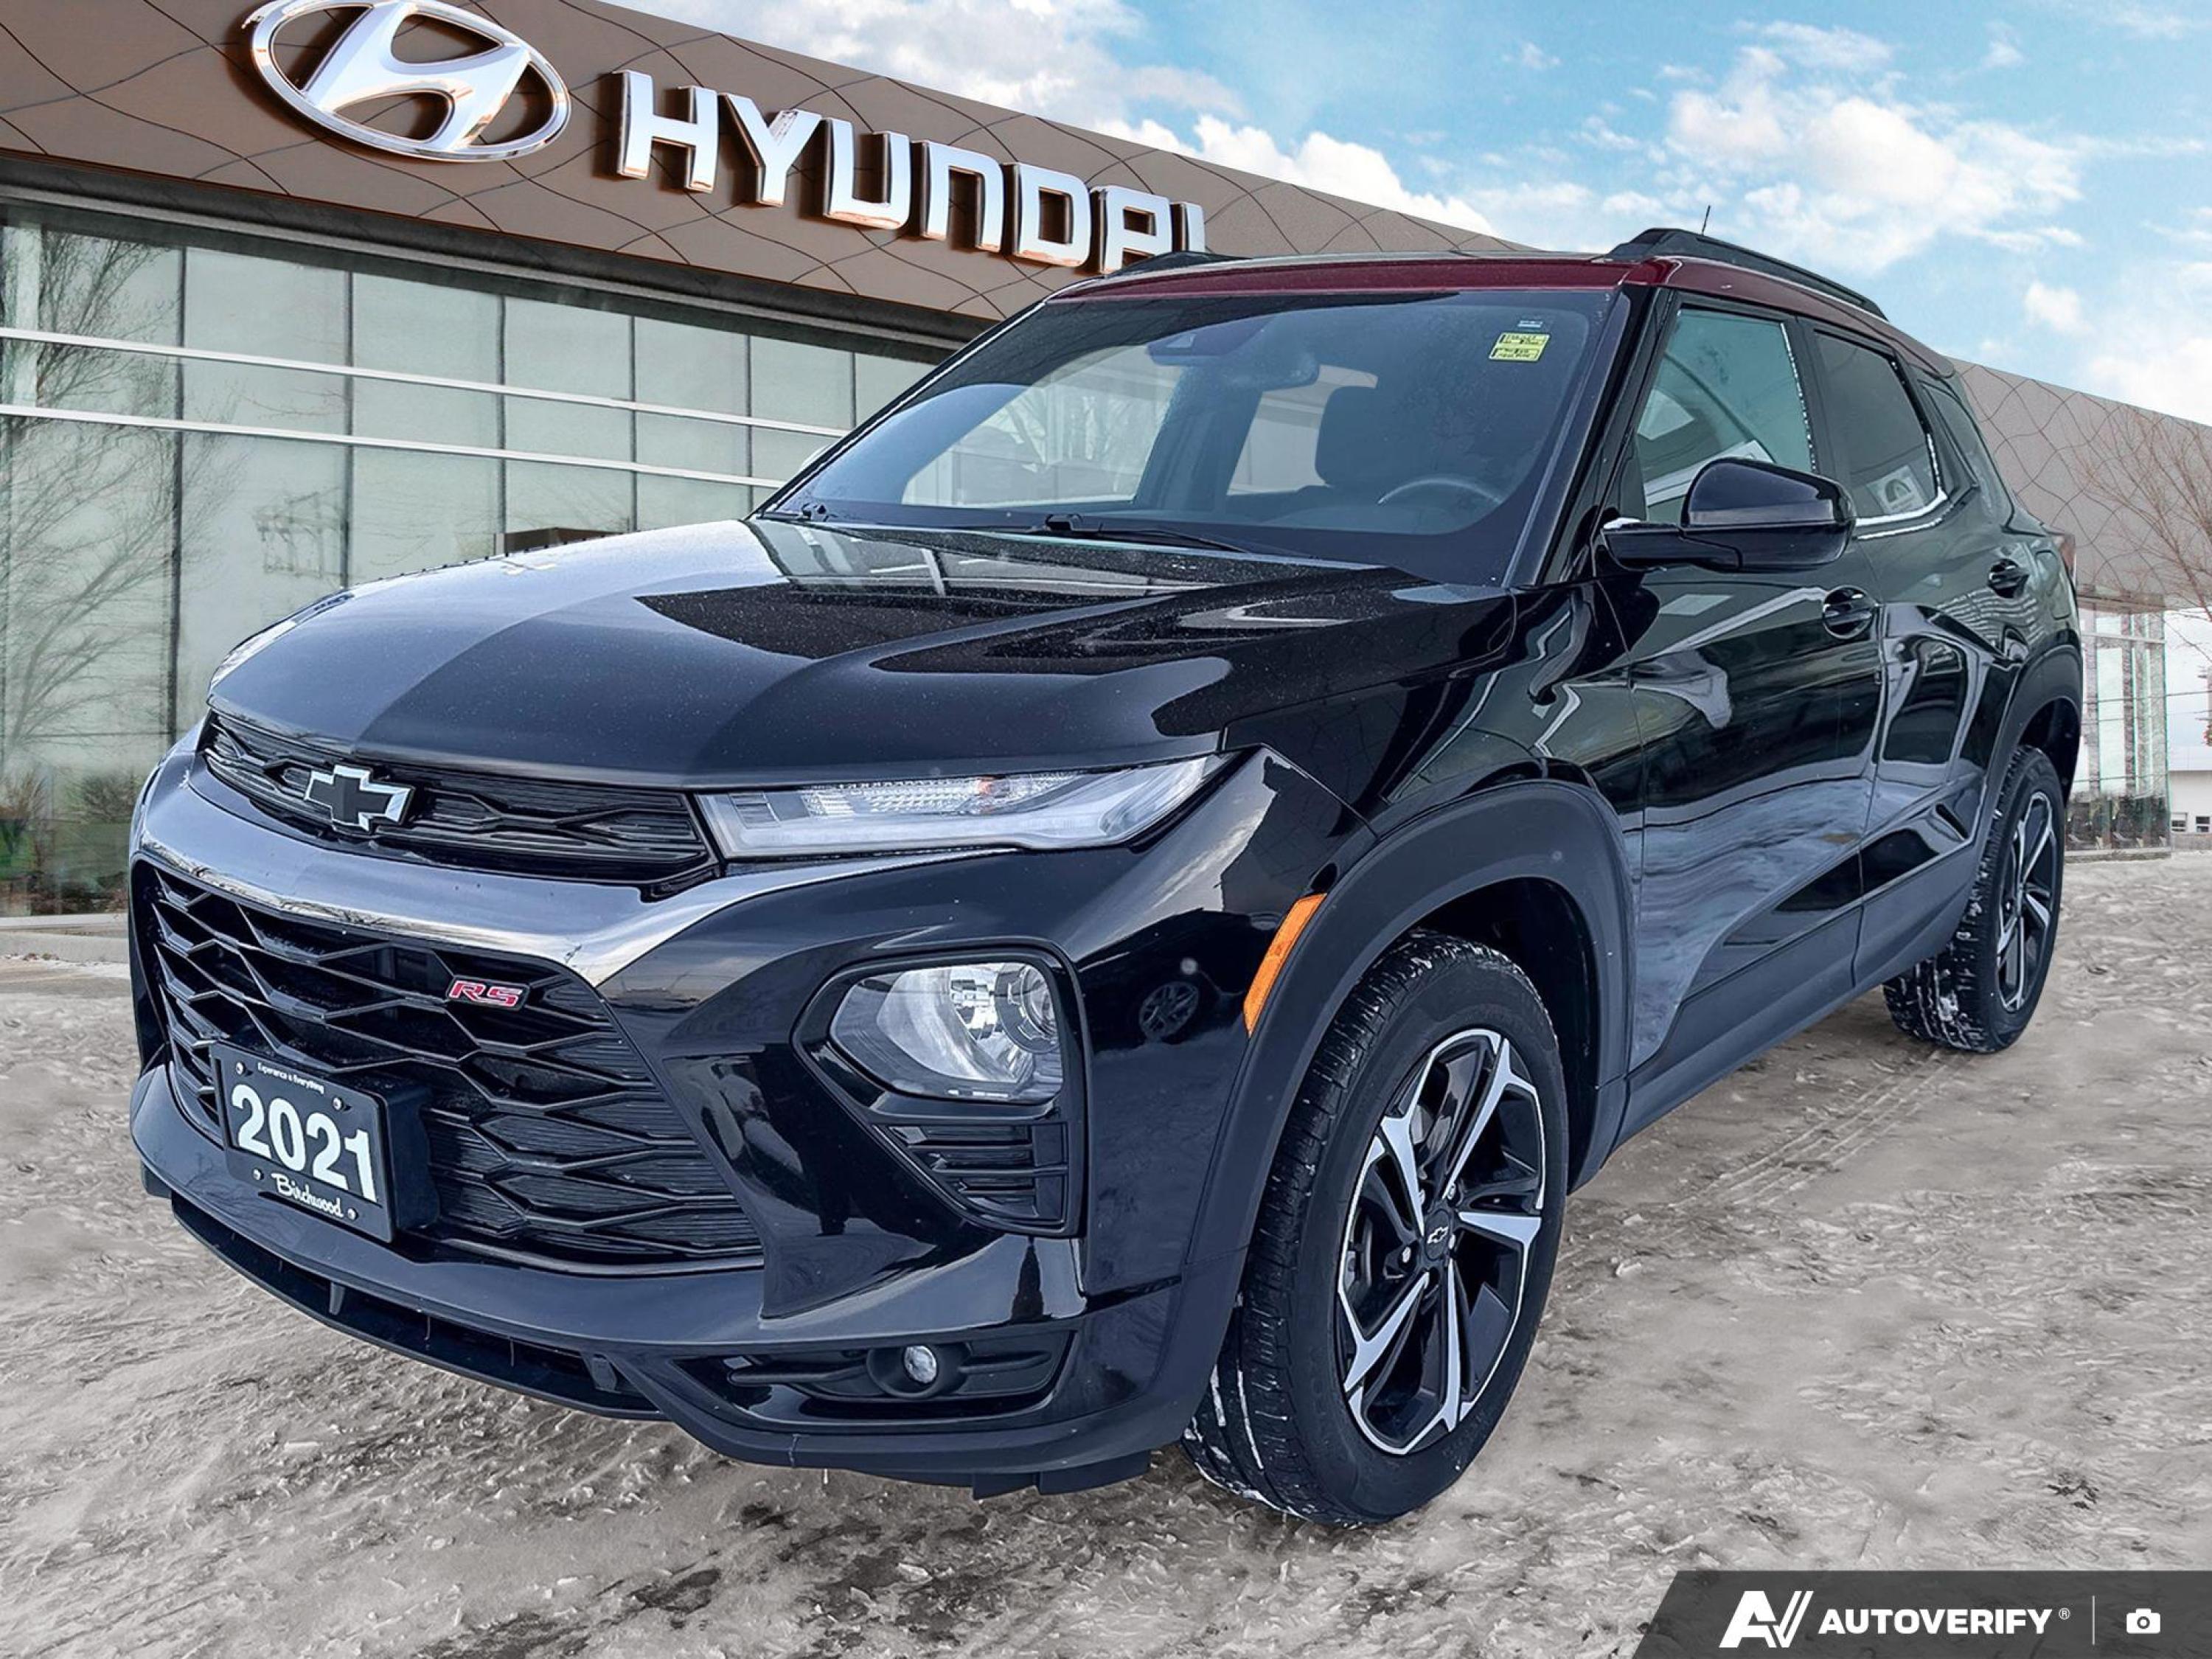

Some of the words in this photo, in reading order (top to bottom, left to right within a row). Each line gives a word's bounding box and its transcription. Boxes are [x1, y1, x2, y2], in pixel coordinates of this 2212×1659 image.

[612, 69, 1206, 275] HYUNDAI
[448, 980, 523, 1007] RS
[231, 1084, 378, 1203] 2021
[270, 1172, 344, 1218] Birchwood
